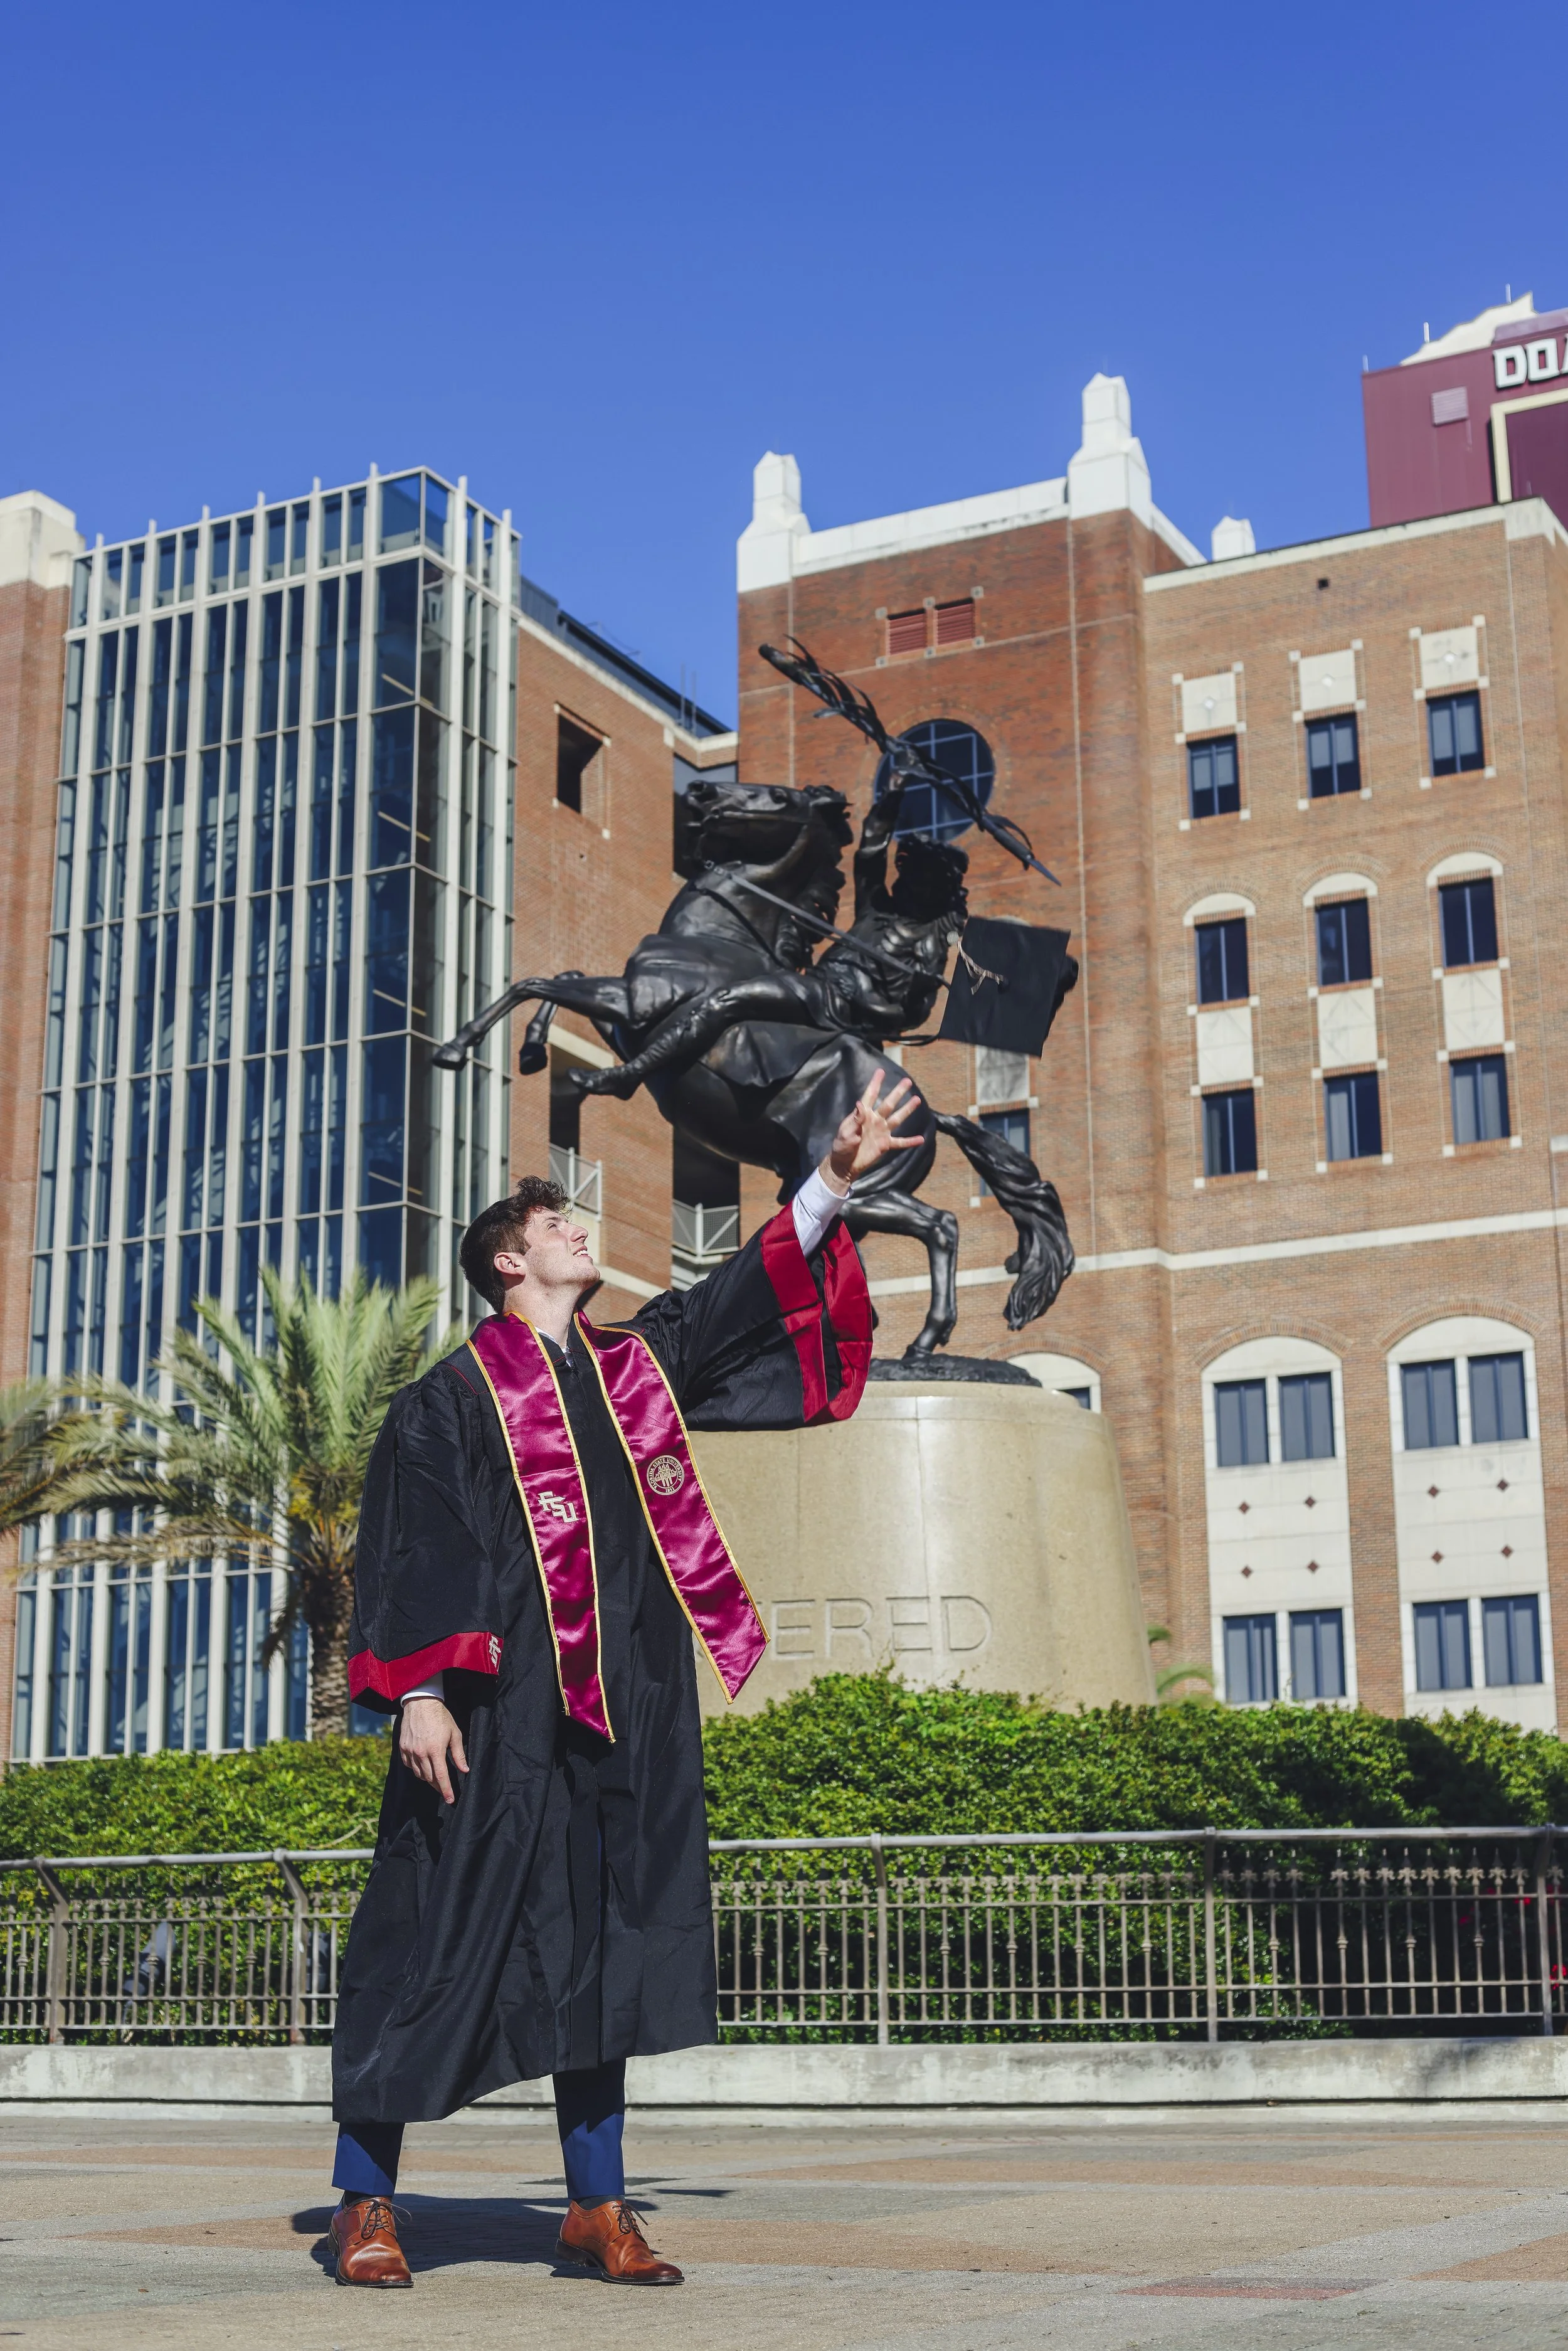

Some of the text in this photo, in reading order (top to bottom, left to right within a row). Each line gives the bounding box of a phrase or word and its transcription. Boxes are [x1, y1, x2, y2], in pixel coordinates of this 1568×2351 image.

[1492, 333, 1568, 388] DO
[649, 1458, 682, 1489] FLORIDA STATE UNIVERSITY
[538, 1491, 579, 1523] FSU
[755, 1595, 993, 1661] ERED
[489, 1635, 501, 1672] FS
